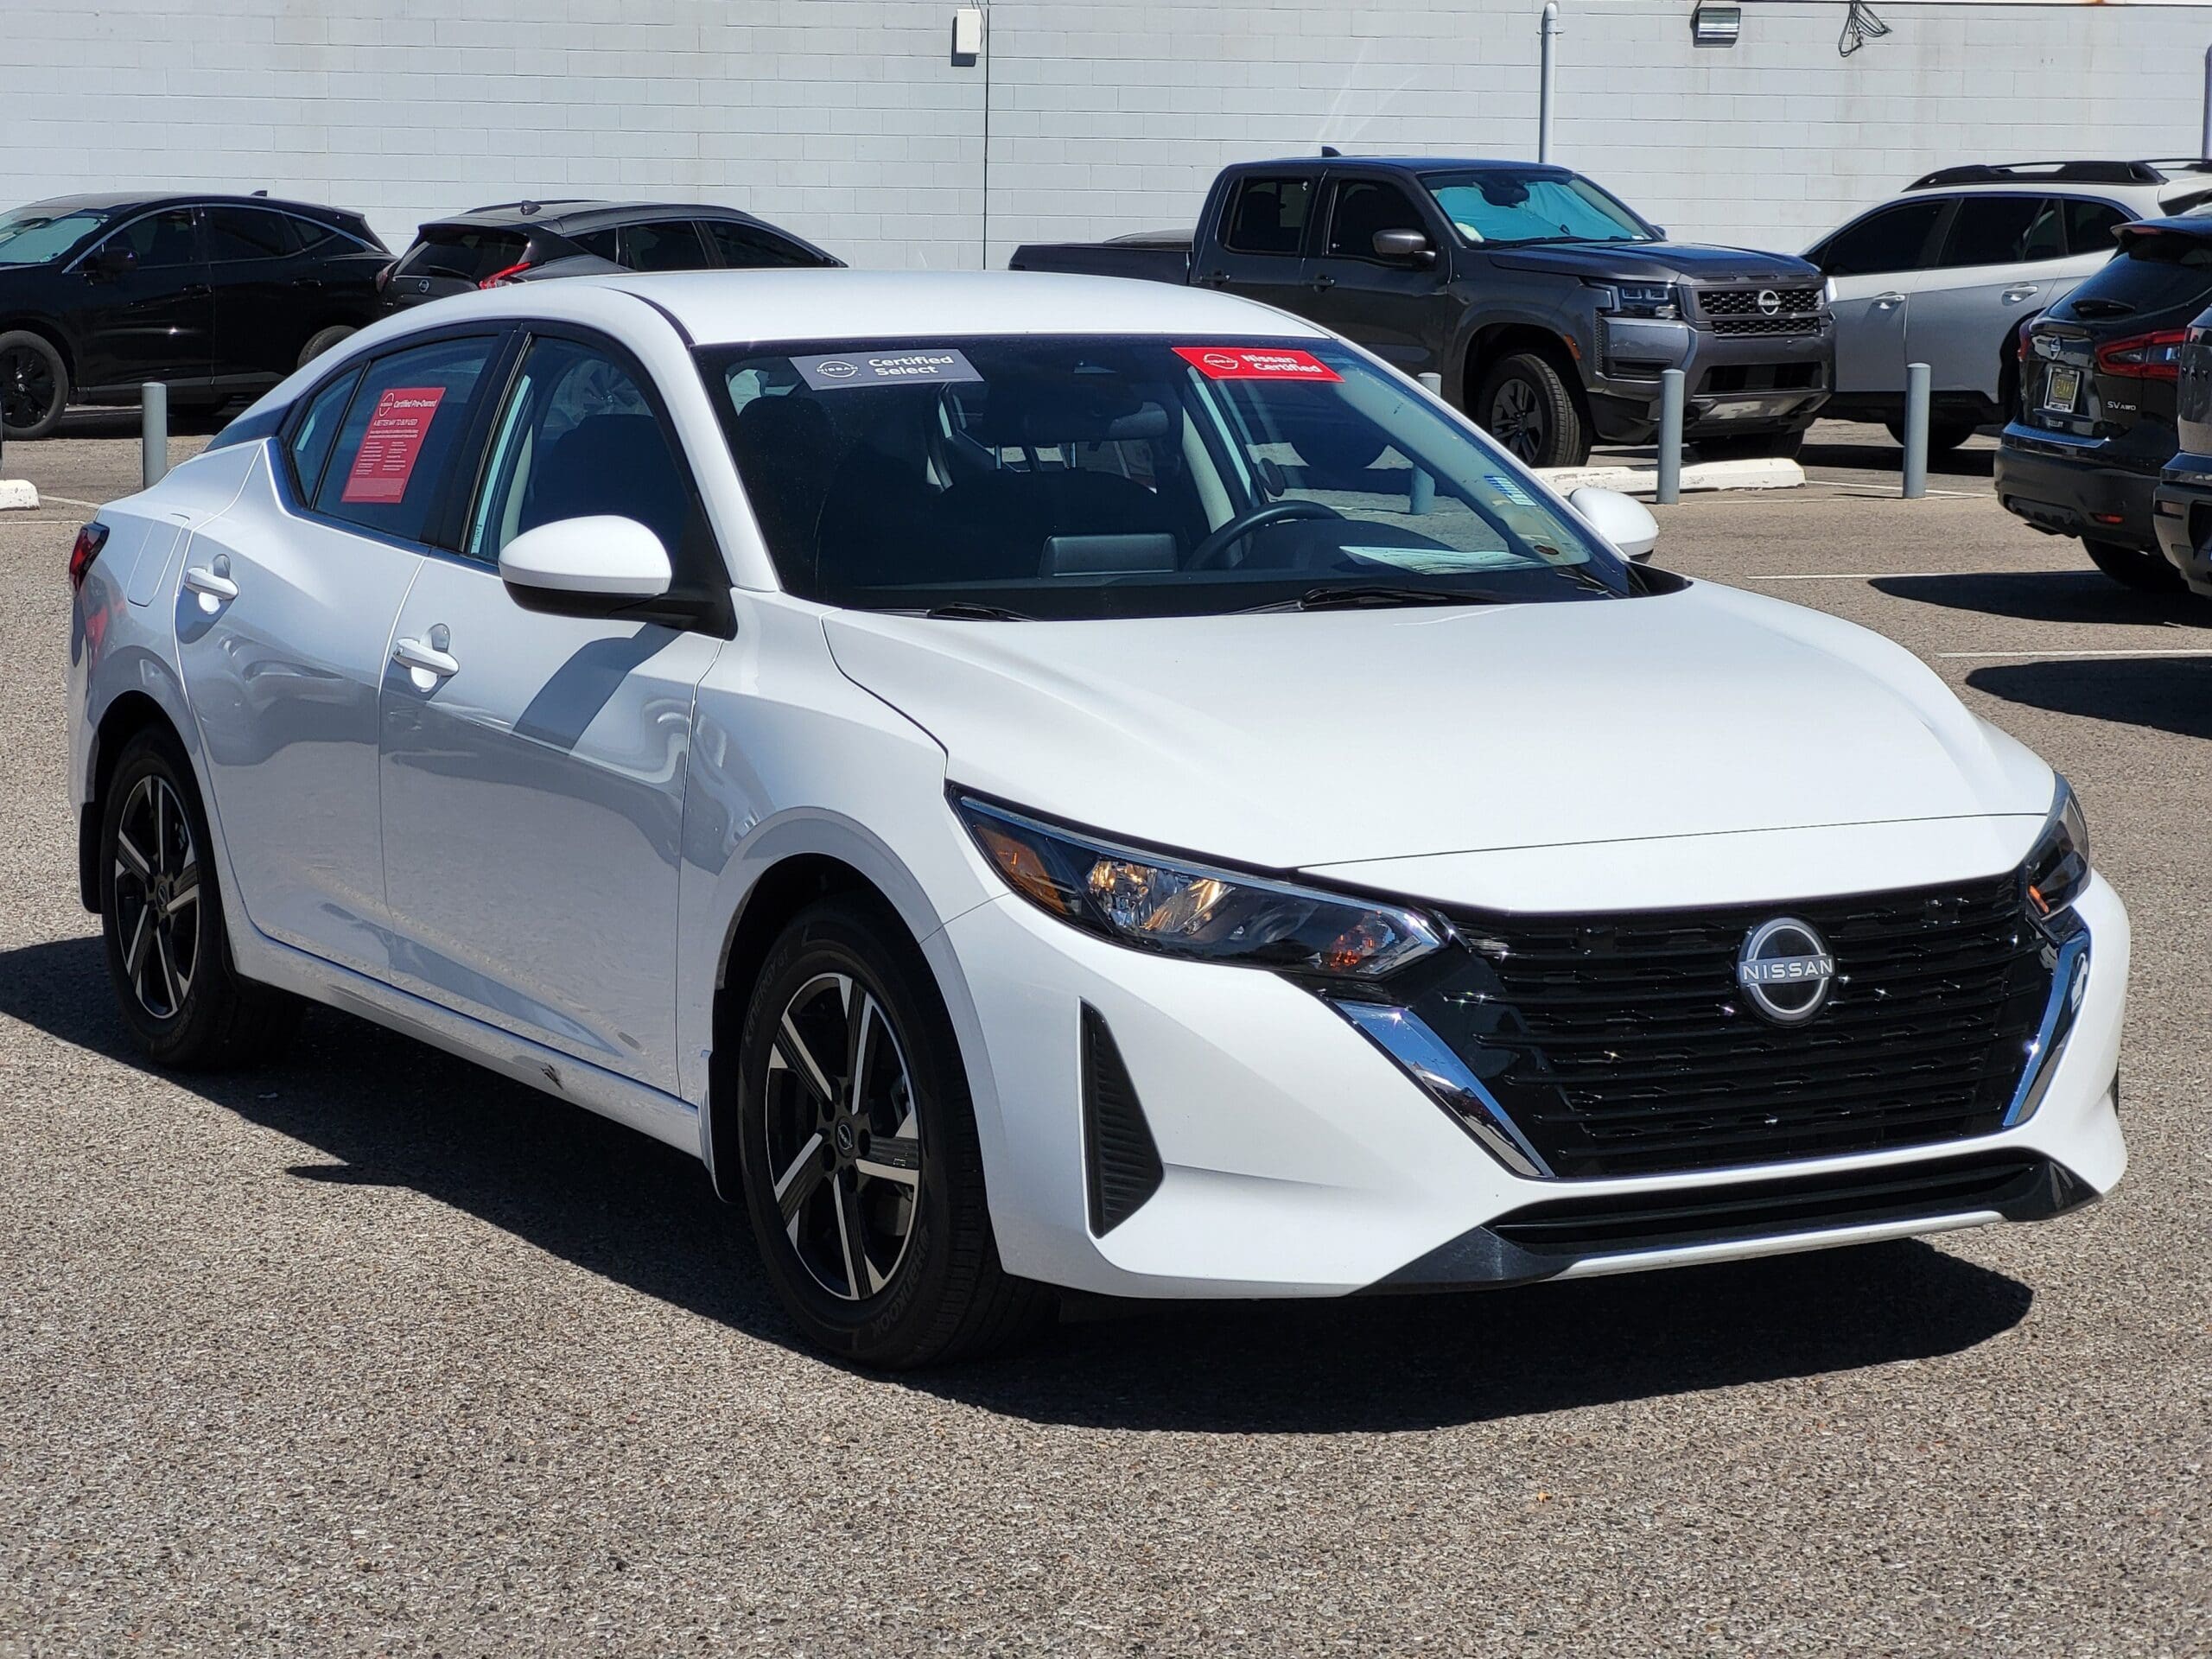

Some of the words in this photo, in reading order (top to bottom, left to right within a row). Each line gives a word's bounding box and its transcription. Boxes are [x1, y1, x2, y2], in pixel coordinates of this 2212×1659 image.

[868, 356, 954, 366] Certified
[1240, 354, 1298, 363] Nissan
[874, 365, 938, 376] Select
[1253, 363, 1322, 372] Certified
[1742, 959, 1833, 980] NISSAN
